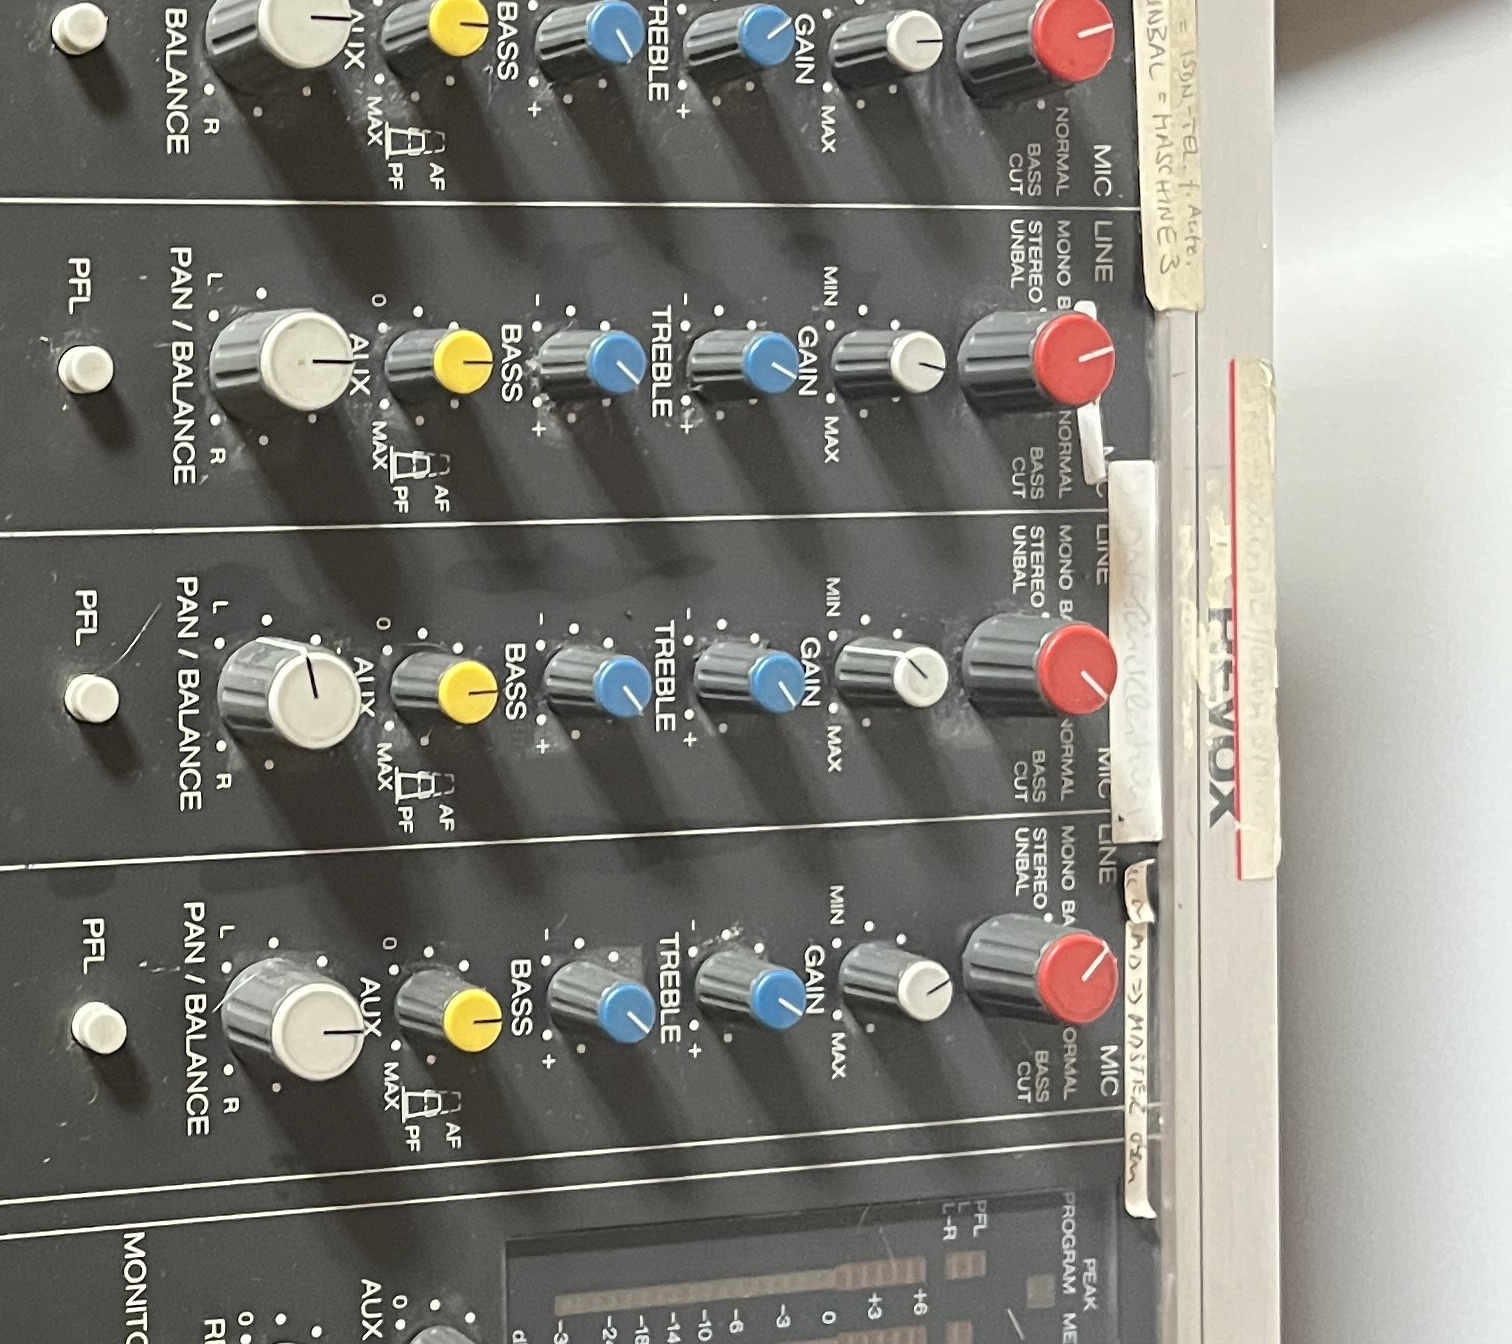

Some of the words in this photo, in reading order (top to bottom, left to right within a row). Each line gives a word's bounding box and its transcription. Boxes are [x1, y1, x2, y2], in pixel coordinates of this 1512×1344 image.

[497, 2, 518, 80] BASS
[795, 14, 815, 83] GAIN
[166, 9, 189, 154] BALANCE
[366, 96, 383, 145] MAX
[821, 106, 835, 152] MAX
[388, 163, 403, 190] PF
[430, 163, 445, 190] AF
[1009, 154, 1023, 195] CUT
[1028, 144, 1041, 196] BASS
[1094, 145, 1111, 196] MIC
[1153, 114, 1178, 246] MASCHINE
[171, 248, 193, 309] PAN
[1011, 220, 1025, 288] UNBAL
[1029, 221, 1043, 303] STEREO
[1057, 221, 1071, 286] MONO
[1095, 221, 1113, 281] LINE
[1160, 254, 1179, 274] 3
[69, 258, 91, 314] PFL
[502, 324, 523, 401] BASS
[652, 305, 672, 417] TREBLE
[798, 326, 818, 395] GAIN
[172, 342, 195, 485] BALANCE
[1058, 411, 1072, 498] NORMAL
[1013, 526, 1026, 594] UNBAL
[1031, 527, 1045, 607] STEREO
[1059, 525, 1073, 590] MONO
[75, 590, 97, 646] PFL
[177, 577, 198, 637] PAN
[827, 578, 840, 616] MIN
[505, 644, 526, 720] BASS
[655, 620, 675, 732] TREBLE
[800, 637, 821, 706] GAIN
[178, 669, 201, 811] BALANCE
[828, 726, 841, 772] MAX
[1014, 762, 1028, 802] CUT
[1032, 750, 1046, 802] BASS
[1015, 828, 1029, 896] UNBAL
[1033, 828, 1047, 909] STEREO
[1061, 826, 1075, 890] MONO
[1099, 824, 1117, 884] LINE
[184, 902, 205, 963] PAN
[830, 886, 844, 924] MIN
[83, 918, 105, 974] PFL
[359, 977, 381, 1037] AUX
[511, 960, 532, 1035] BASS
[660, 932, 681, 1044] TREBLE
[804, 945, 825, 1013] GAIN
[185, 994, 209, 1136] BALANCE
[384, 1062, 399, 1110] MAX
[832, 1033, 846, 1079] MAX
[1017, 1062, 1031, 1103] CUT
[1035, 1051, 1049, 1102] BASS
[1101, 1045, 1119, 1096] MIC
[405, 1126, 420, 1151] PF
[446, 1123, 461, 1148] AF
[973, 1200, 987, 1237] PFL
[1062, 1191, 1076, 1294] PROGRAM
[361, 1279, 383, 1340] AUX
[868, 1294, 882, 1319] +3
[914, 1289, 927, 1315] +6
[1083, 1258, 1097, 1311] PEAK
[667, 1312, 681, 1343] -14
[698, 1309, 712, 1341] -10
[730, 1309, 743, 1333] -6
[777, 1305, 790, 1328] -3
